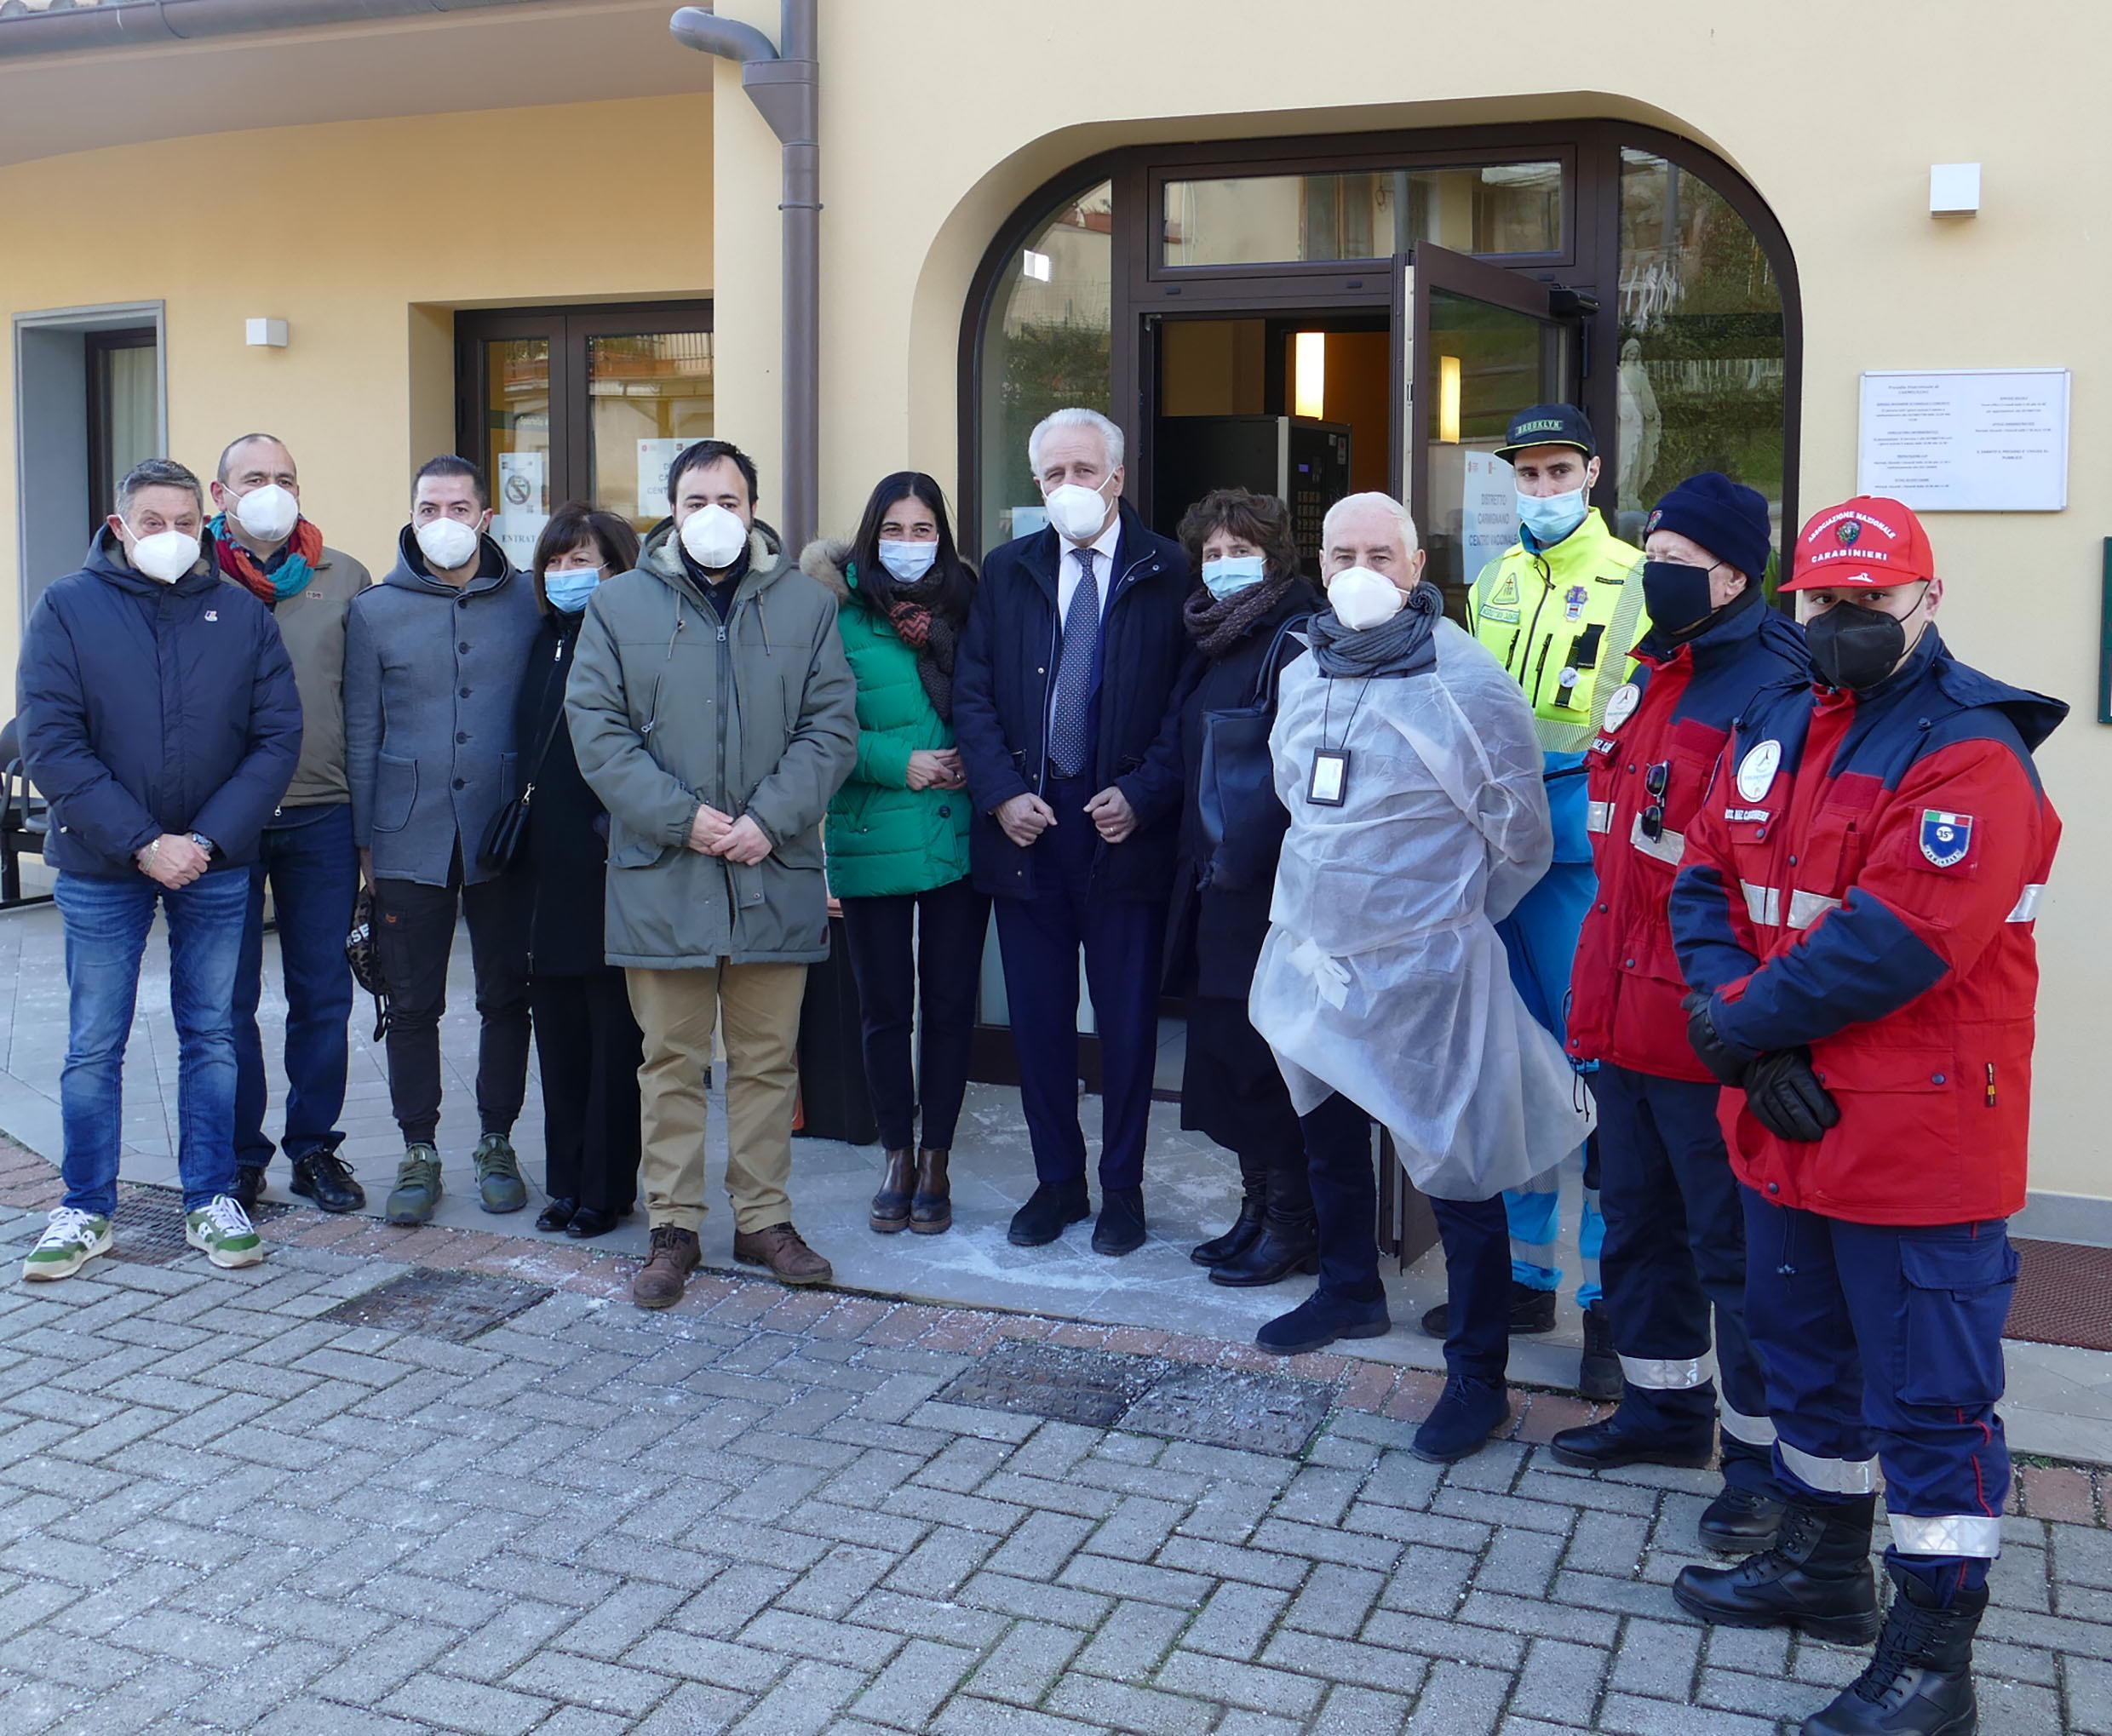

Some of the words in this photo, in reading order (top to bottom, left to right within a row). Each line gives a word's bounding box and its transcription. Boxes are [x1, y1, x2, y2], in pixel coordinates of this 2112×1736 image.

[1517, 420, 1561, 435] BROOKLYN
[1808, 511, 1855, 543] ASSOCIAZIONE
[1856, 512, 1897, 540] NAZIONALE
[1811, 548, 1888, 563] CARABINIERI
